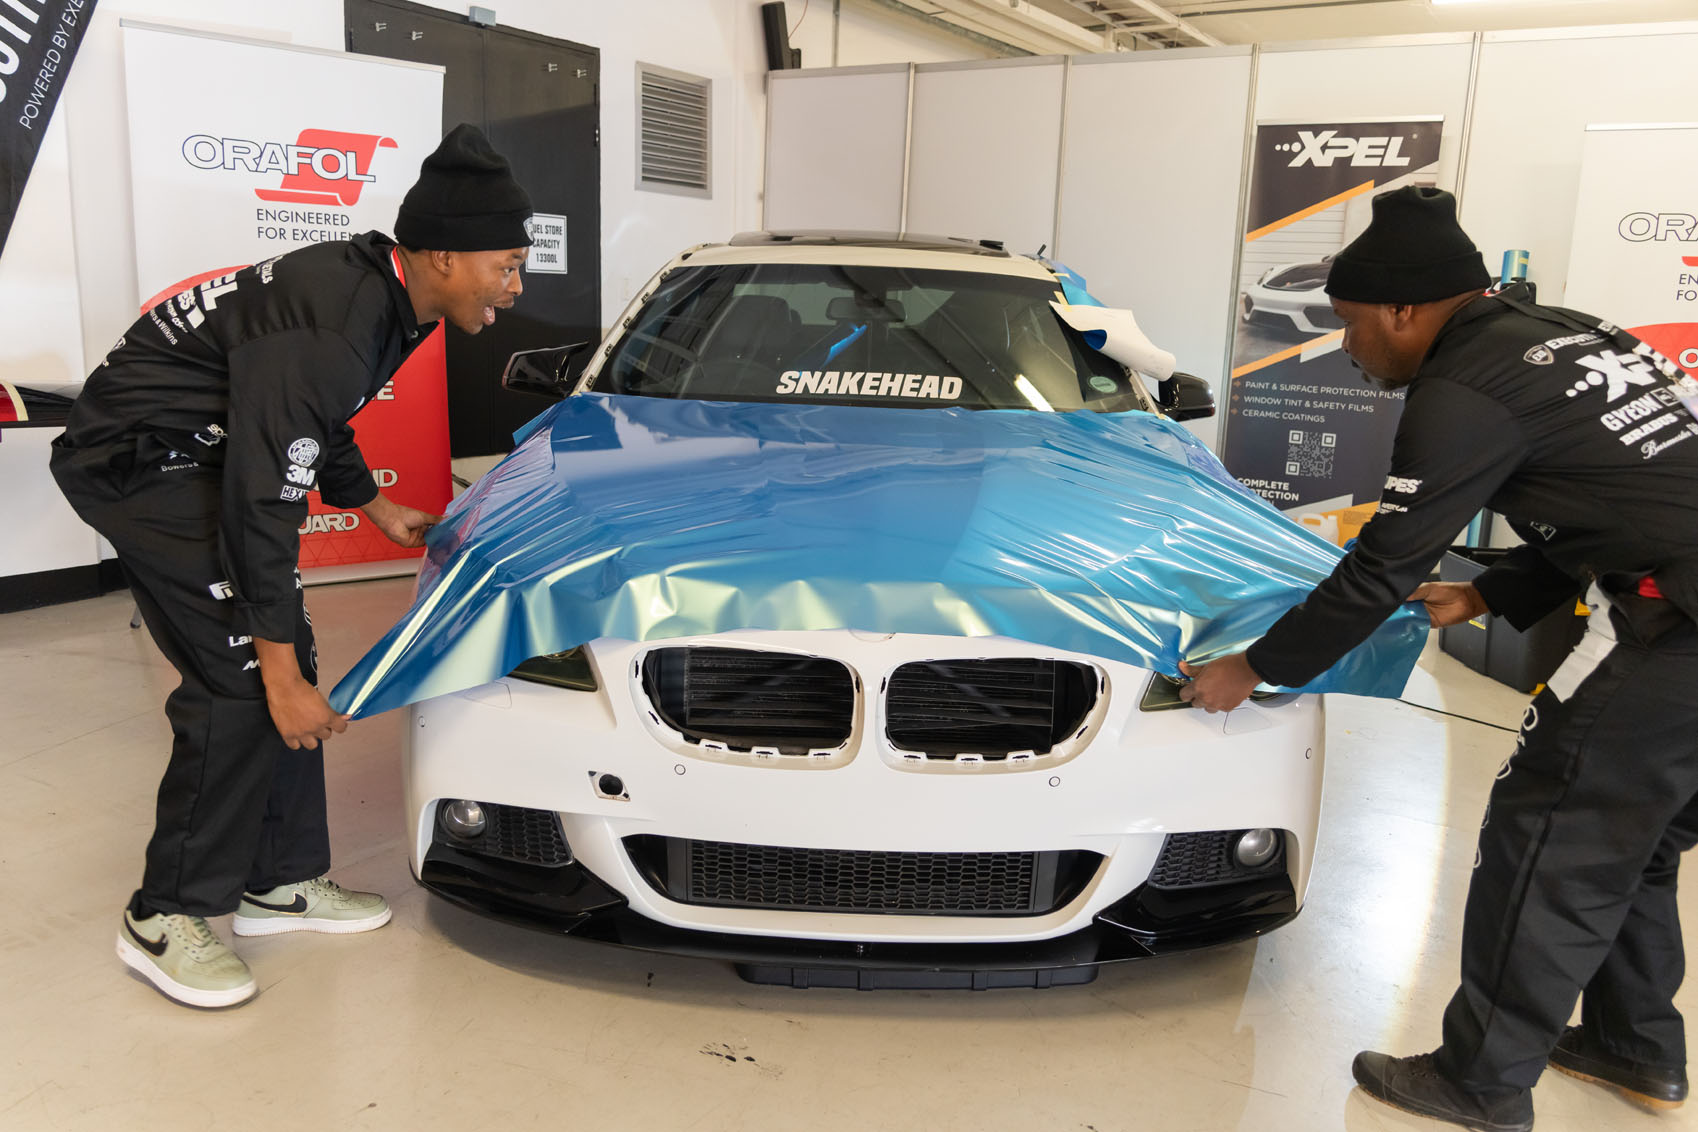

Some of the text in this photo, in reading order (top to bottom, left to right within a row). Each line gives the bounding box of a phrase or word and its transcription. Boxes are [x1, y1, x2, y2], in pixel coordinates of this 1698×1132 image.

[19, 49, 61, 130] POWERED
[52, 24, 71, 49] BY
[182, 134, 377, 183] ORAFOL
[1287, 130, 1411, 168] XPEL
[256, 208, 351, 227] ENGINEERED
[257, 226, 287, 240] FOR
[533, 224, 562, 235] UEL STORE
[775, 369, 964, 401] SNAKEHEAD
[1245, 380, 1406, 400] PAINT & SURFACE PROTECTION FILMS
[1243, 395, 1375, 413] WINDOW TINT & SAFETY FILMS
[1600, 393, 1664, 432] GYEON
[1242, 408, 1326, 423] CERAMIC COATINGS
[286, 464, 316, 487] 3M
[1250, 488, 1300, 502] TECTION
